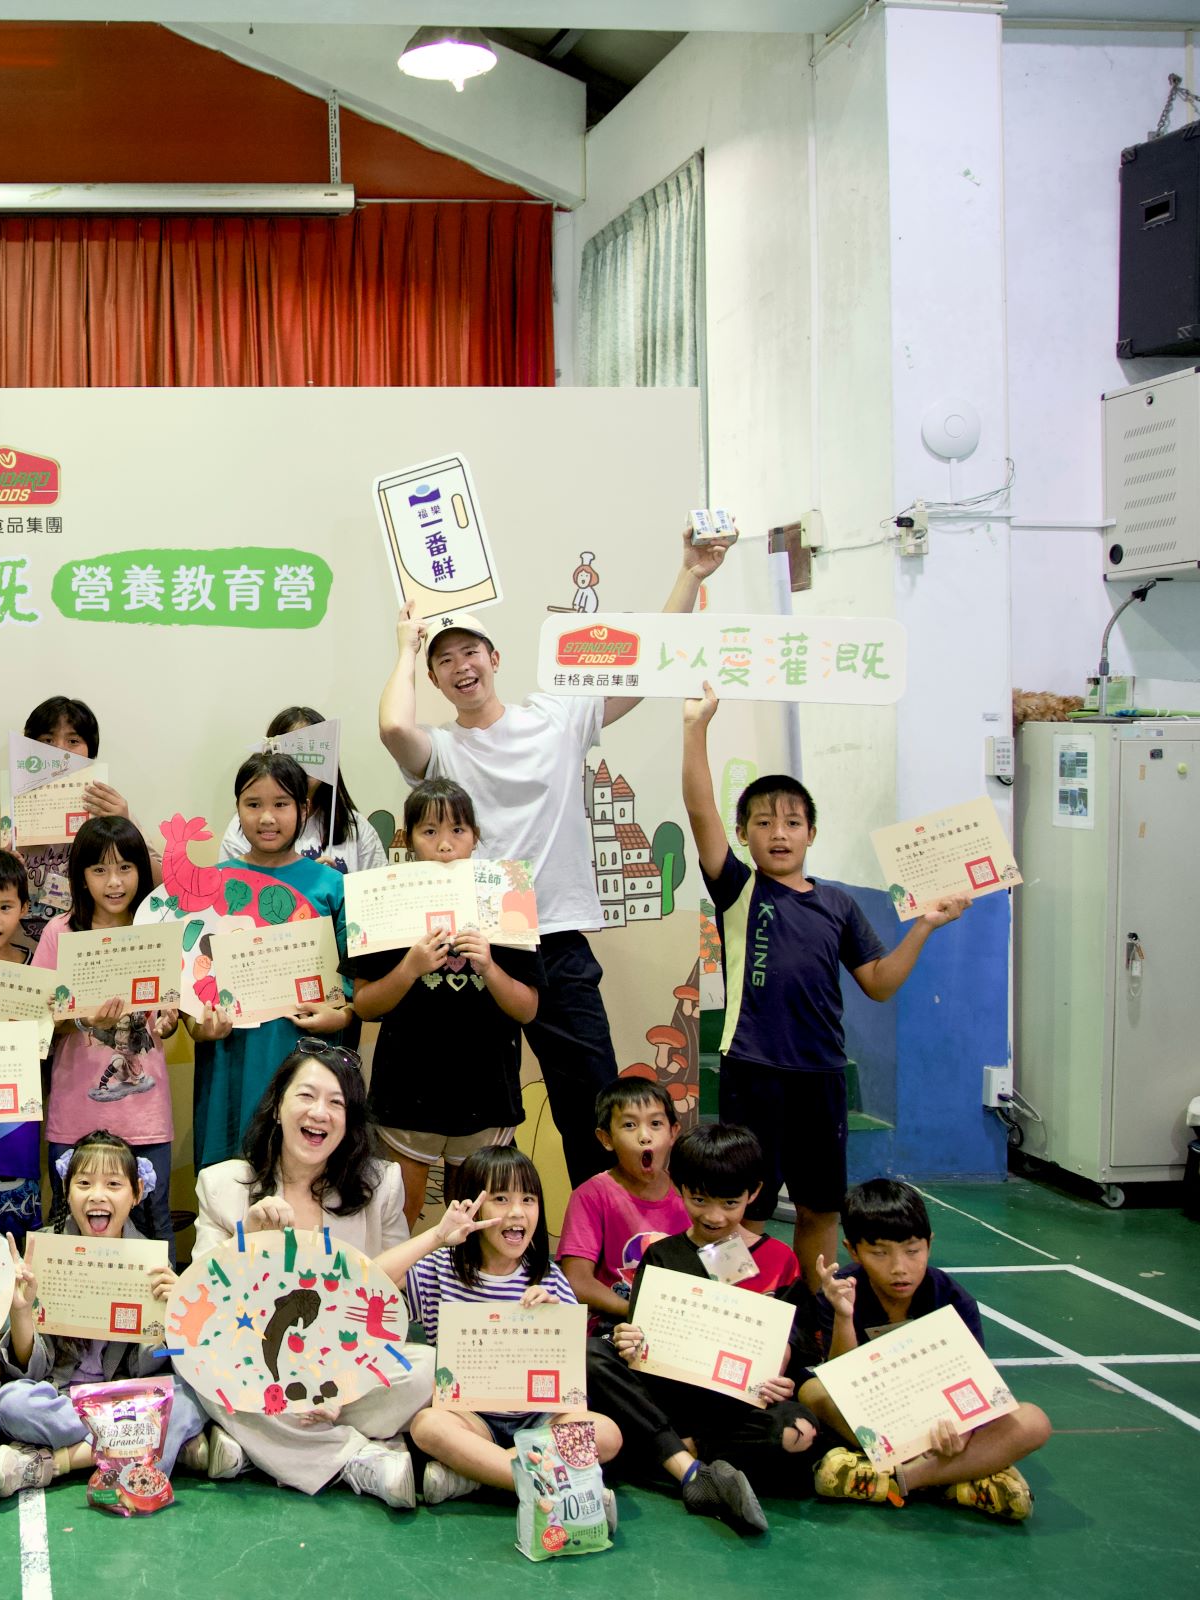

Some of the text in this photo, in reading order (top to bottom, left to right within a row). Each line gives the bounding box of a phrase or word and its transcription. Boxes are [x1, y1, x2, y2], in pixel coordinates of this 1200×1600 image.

[417, 504, 442, 520] 福樂
[420, 518, 457, 583] 一番鮮
[71, 563, 316, 612] 營養教育營
[563, 641, 633, 656] STANDARD
[577, 653, 616, 664] FOODS
[657, 626, 891, 688] 以愛灌溉
[553, 673, 640, 688] 佳格食品集團
[475, 871, 502, 886] 法師
[751, 901, 775, 988] K-JING
[108, 1437, 145, 1448] Granola
[561, 1494, 580, 1521] 10
